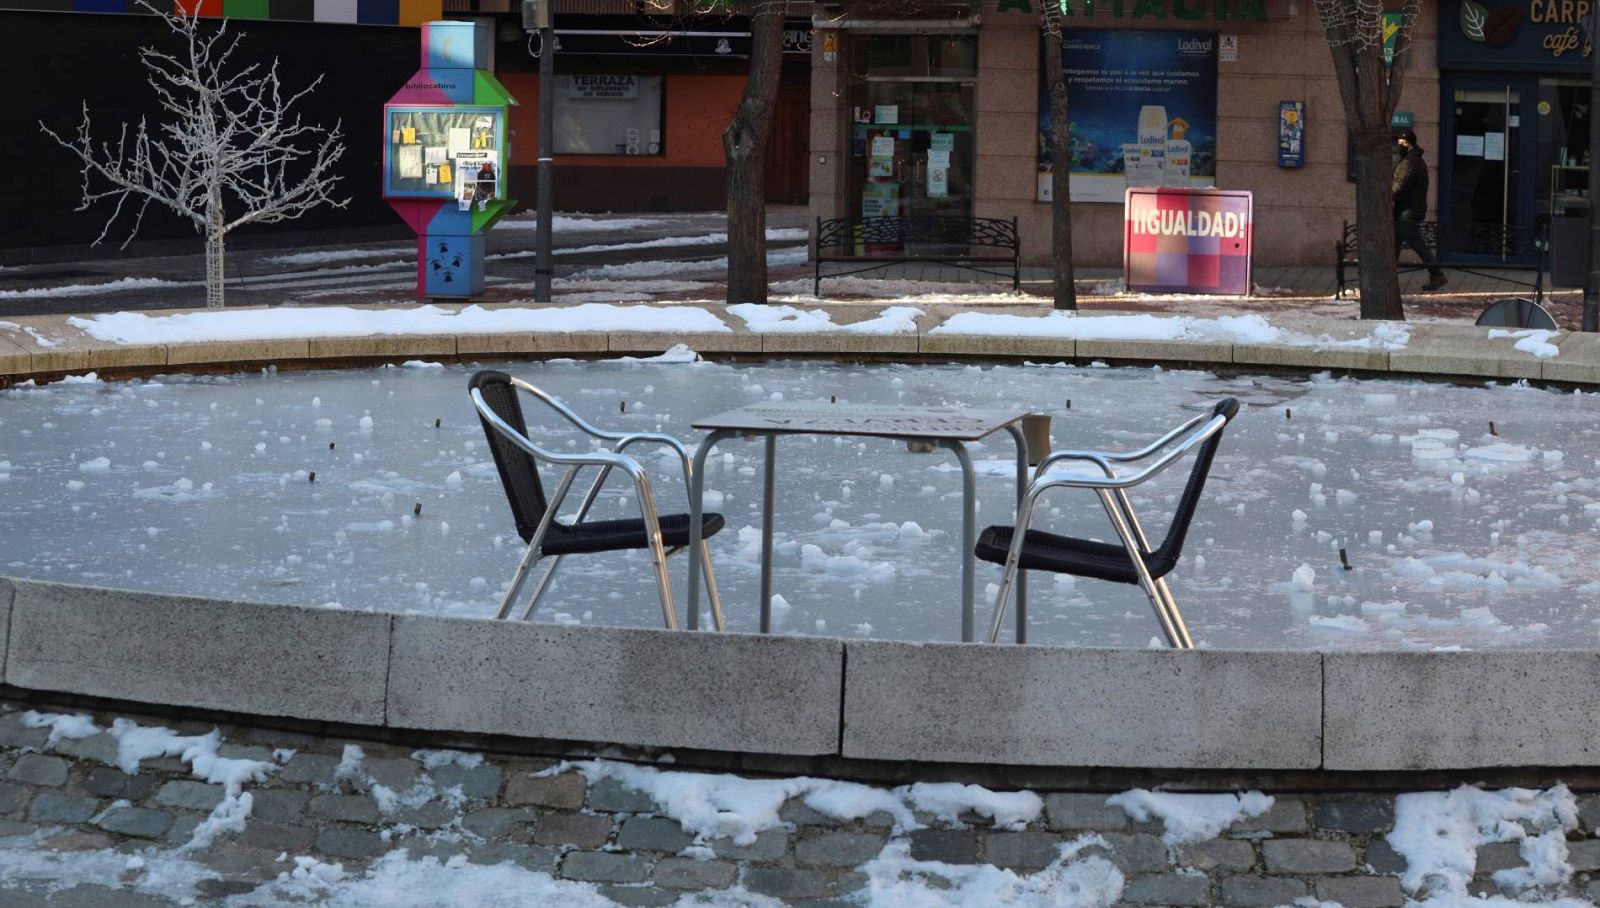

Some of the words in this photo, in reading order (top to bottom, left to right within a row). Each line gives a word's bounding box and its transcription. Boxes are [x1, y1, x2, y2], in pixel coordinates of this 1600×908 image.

[1178, 37, 1212, 51] Ladival
[1543, 26, 1580, 57] café
[405, 81, 457, 90] bibliocabina
[573, 76, 634, 86] TERRAZA
[1140, 135, 1165, 144] Ladival
